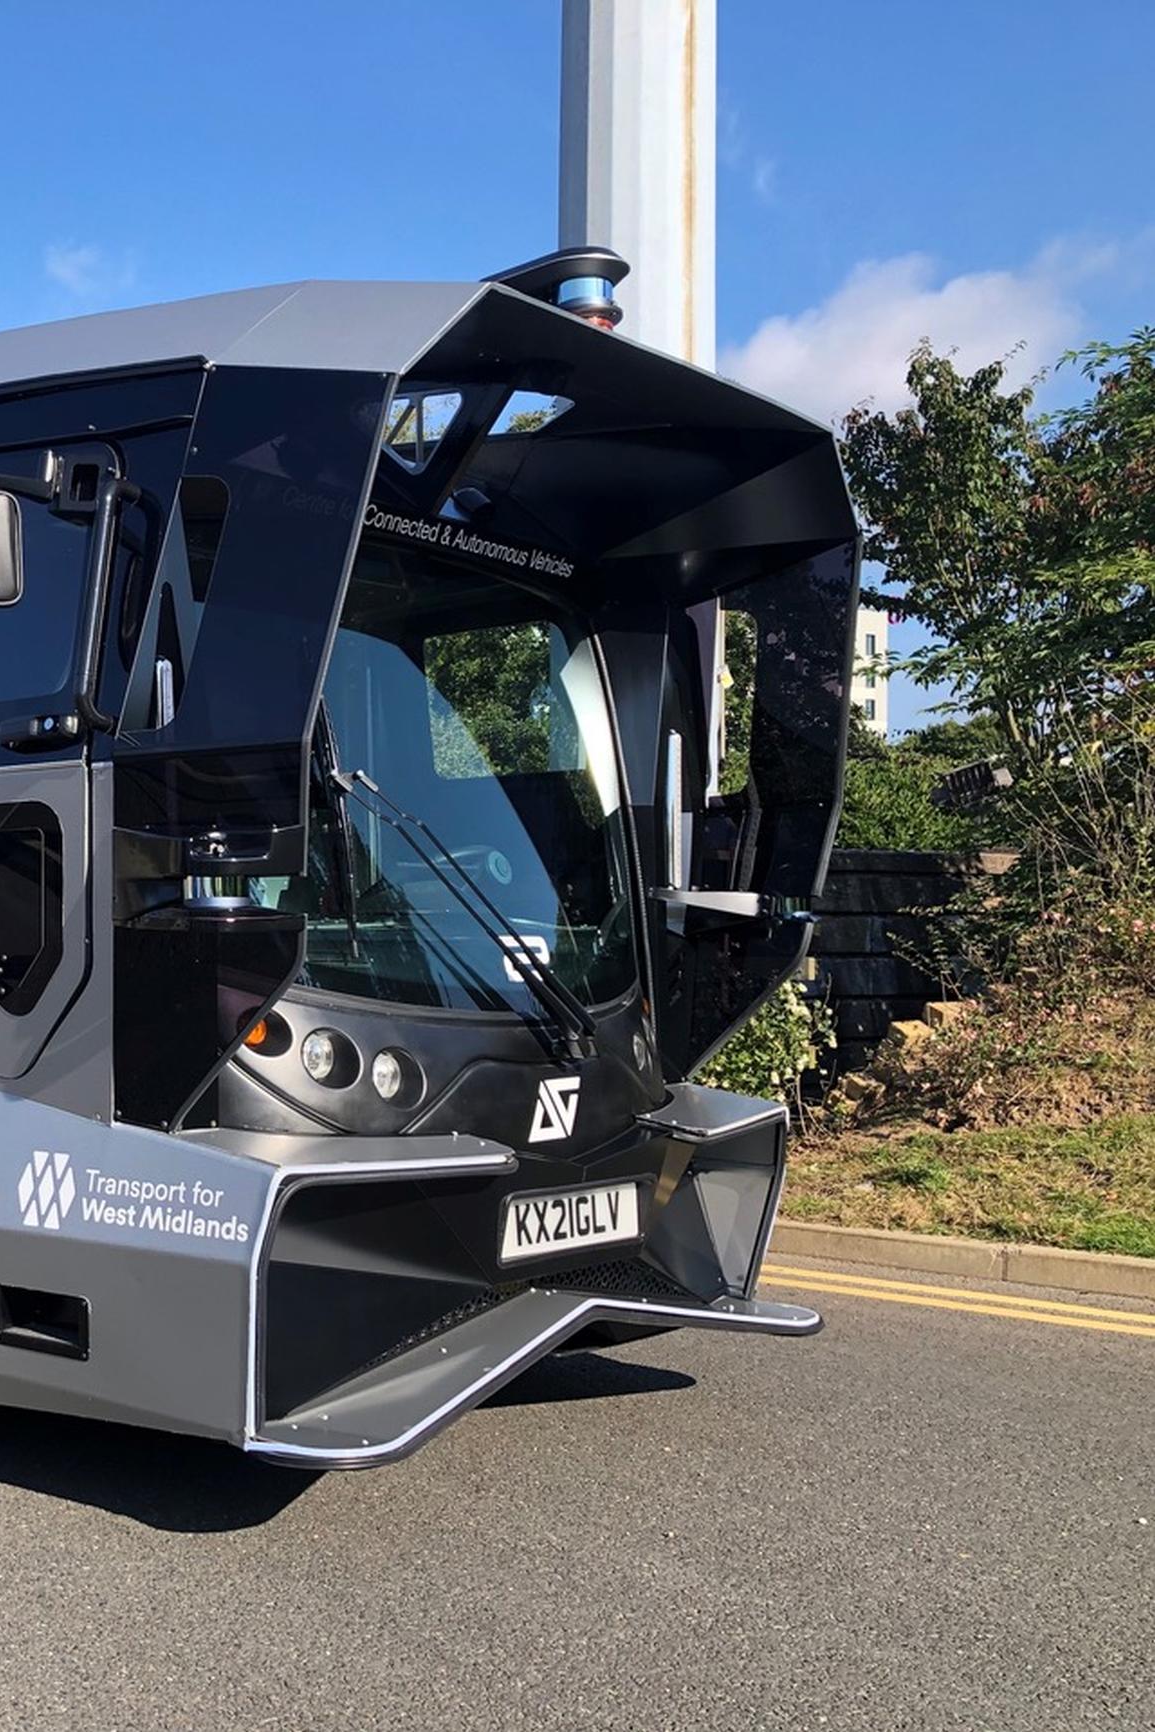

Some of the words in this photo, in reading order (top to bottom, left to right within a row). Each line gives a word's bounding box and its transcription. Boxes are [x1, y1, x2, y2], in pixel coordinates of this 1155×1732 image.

[363, 504, 441, 542] Connected
[440, 524, 451, 545] &
[452, 528, 529, 567] Autonomous
[529, 548, 575, 578] Vehicles
[86, 1168, 186, 1204] Transport
[192, 1180, 225, 1208] for
[81, 1197, 136, 1227] West
[139, 1205, 249, 1242] Midlands
